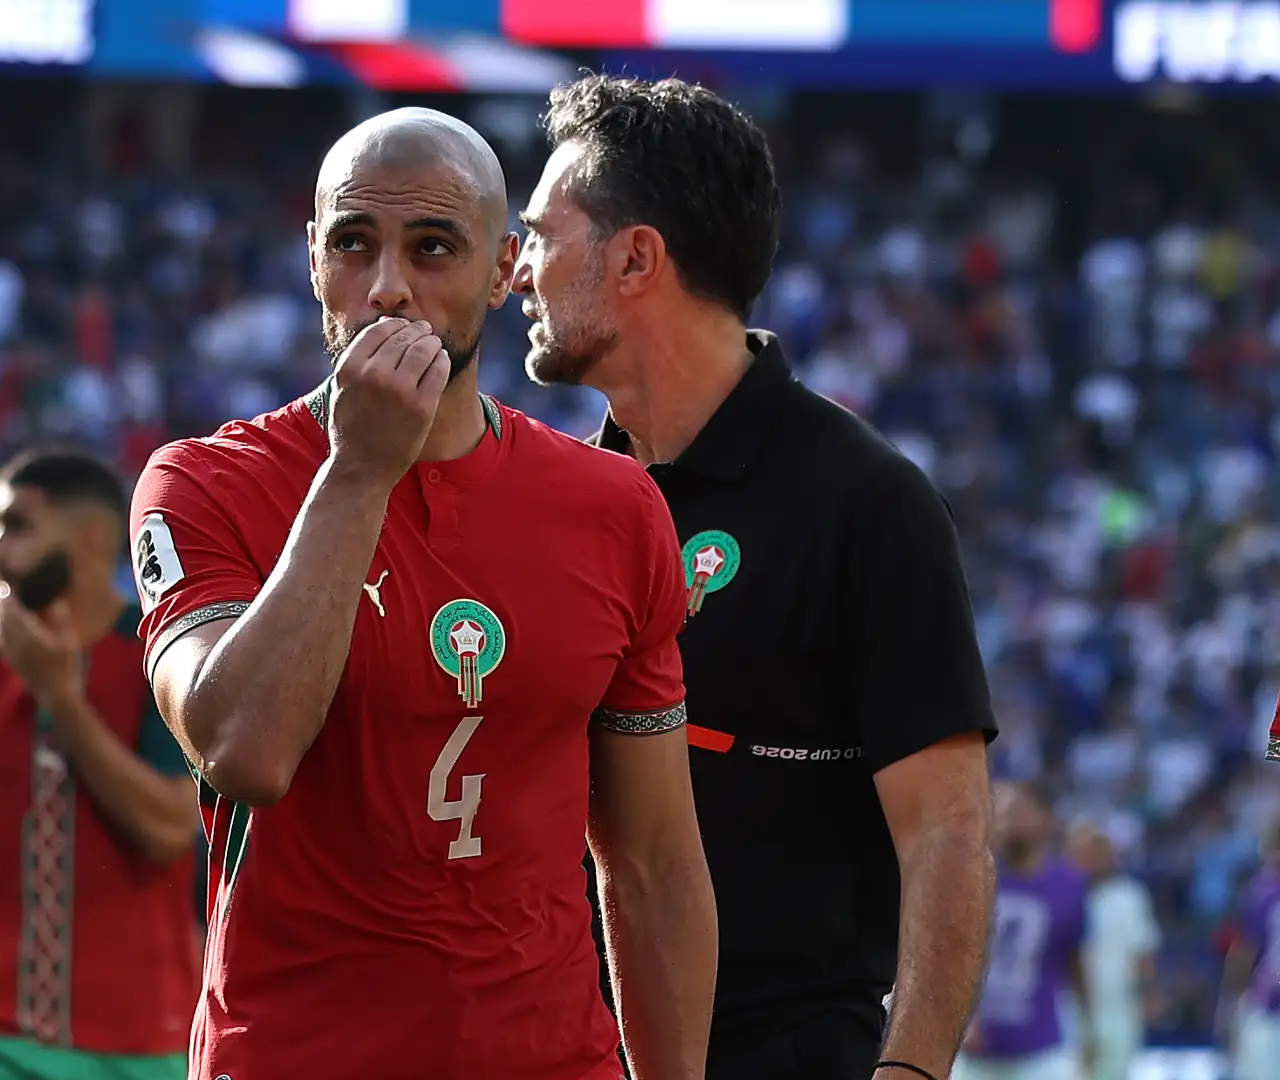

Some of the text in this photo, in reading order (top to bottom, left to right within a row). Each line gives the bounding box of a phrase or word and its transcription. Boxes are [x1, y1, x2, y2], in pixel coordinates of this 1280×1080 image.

[751, 744, 809, 760] 2026
[810, 748, 841, 761] CUP
[427, 716, 486, 859] 4
